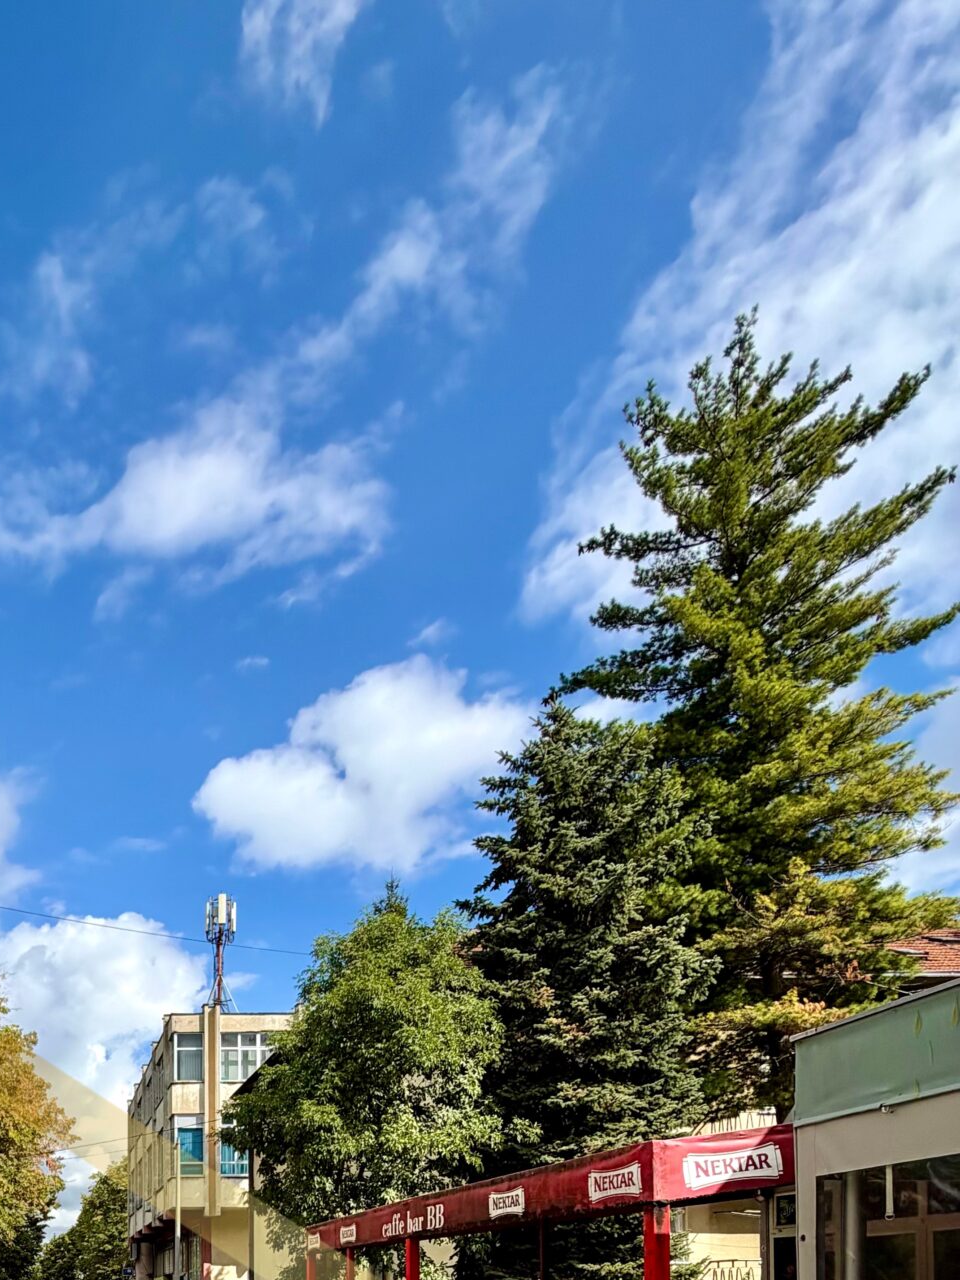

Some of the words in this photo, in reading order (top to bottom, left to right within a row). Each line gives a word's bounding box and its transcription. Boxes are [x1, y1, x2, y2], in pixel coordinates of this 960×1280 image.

[694, 1151, 772, 1178] NEKTAR
[594, 1171, 636, 1193] NEKTAR
[492, 1193, 521, 1211] NEKTAR
[382, 1213, 404, 1238] caffe
[406, 1211, 424, 1233] bar
[427, 1204, 445, 1230] BB
